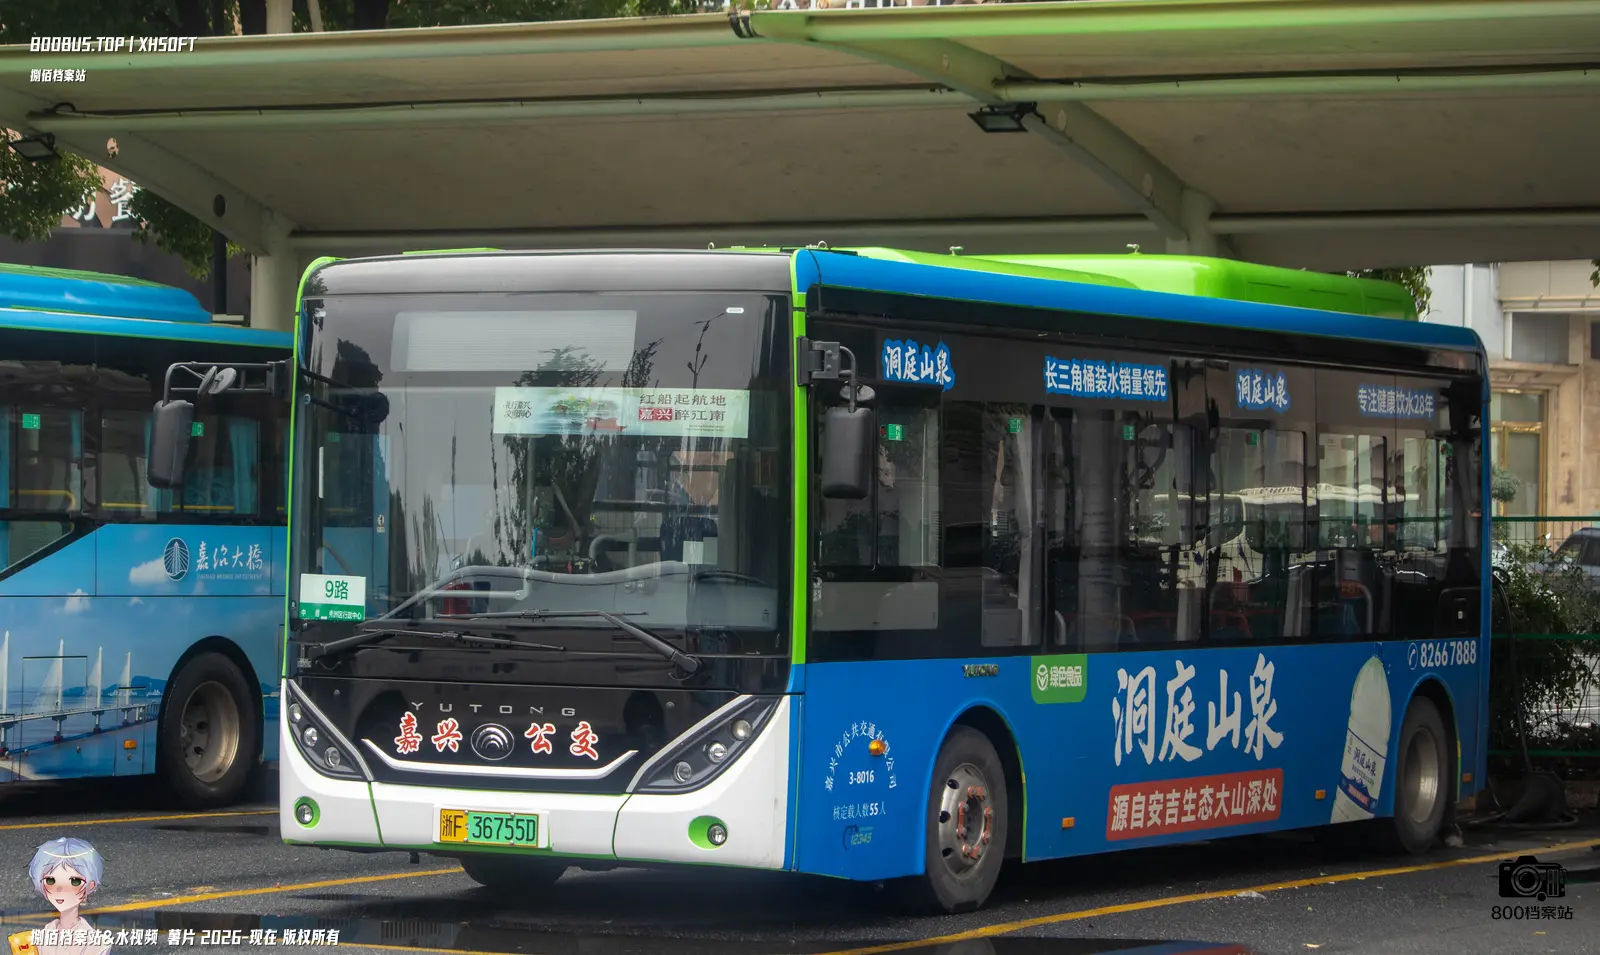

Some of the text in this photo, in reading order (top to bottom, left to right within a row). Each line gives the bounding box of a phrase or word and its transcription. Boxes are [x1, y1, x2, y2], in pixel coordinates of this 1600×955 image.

[884, 345, 952, 385] 洞庭山泉
[1044, 360, 1167, 397] 长三角桶装水销量领先
[640, 393, 727, 406] 红船起航地
[1237, 374, 1288, 408] 洞庭山泉
[1357, 387, 1434, 417] 专注健康饮水28年
[325, 580, 349, 600] 9路
[1420, 640, 1477, 668] 82667888
[411, 702, 576, 716] YUTONG
[1112, 653, 1285, 767] 洞庭山泉
[849, 770, 874, 784] 3-8016
[833, 801, 886, 820] 核定载人数55人
[1111, 778, 1277, 831] 源自安吉生态大山深处
